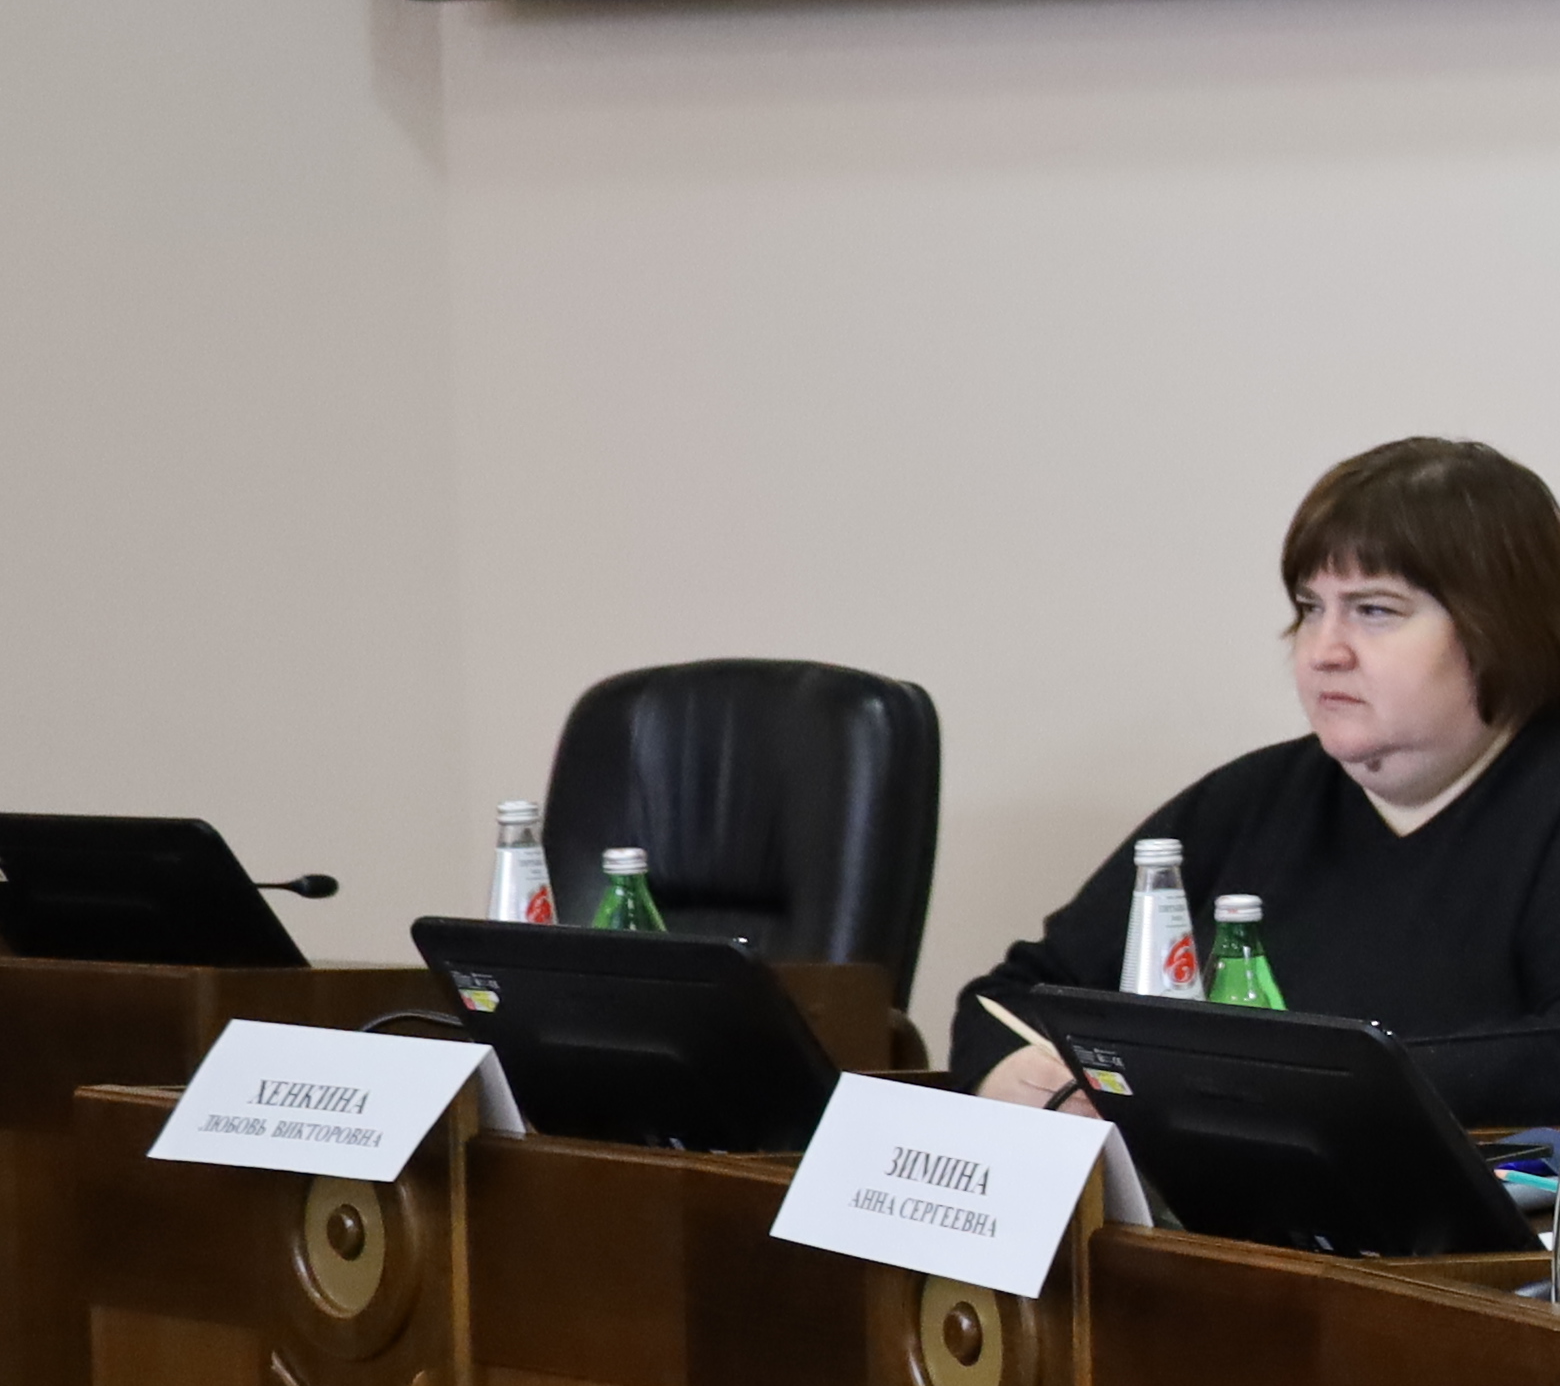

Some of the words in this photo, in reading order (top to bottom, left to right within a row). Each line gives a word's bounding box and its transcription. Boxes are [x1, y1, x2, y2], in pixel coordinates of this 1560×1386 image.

[248, 1079, 371, 1114] ХЕНКИНА
[200, 1114, 268, 1136] ЛЮБОВЬ
[272, 1120, 382, 1147] ВИКТОРОВНА
[885, 1146, 990, 1195] ЗИМИНА
[850, 1188, 896, 1216] АННА
[900, 1198, 997, 1237] СЕРГЕЕВНА
